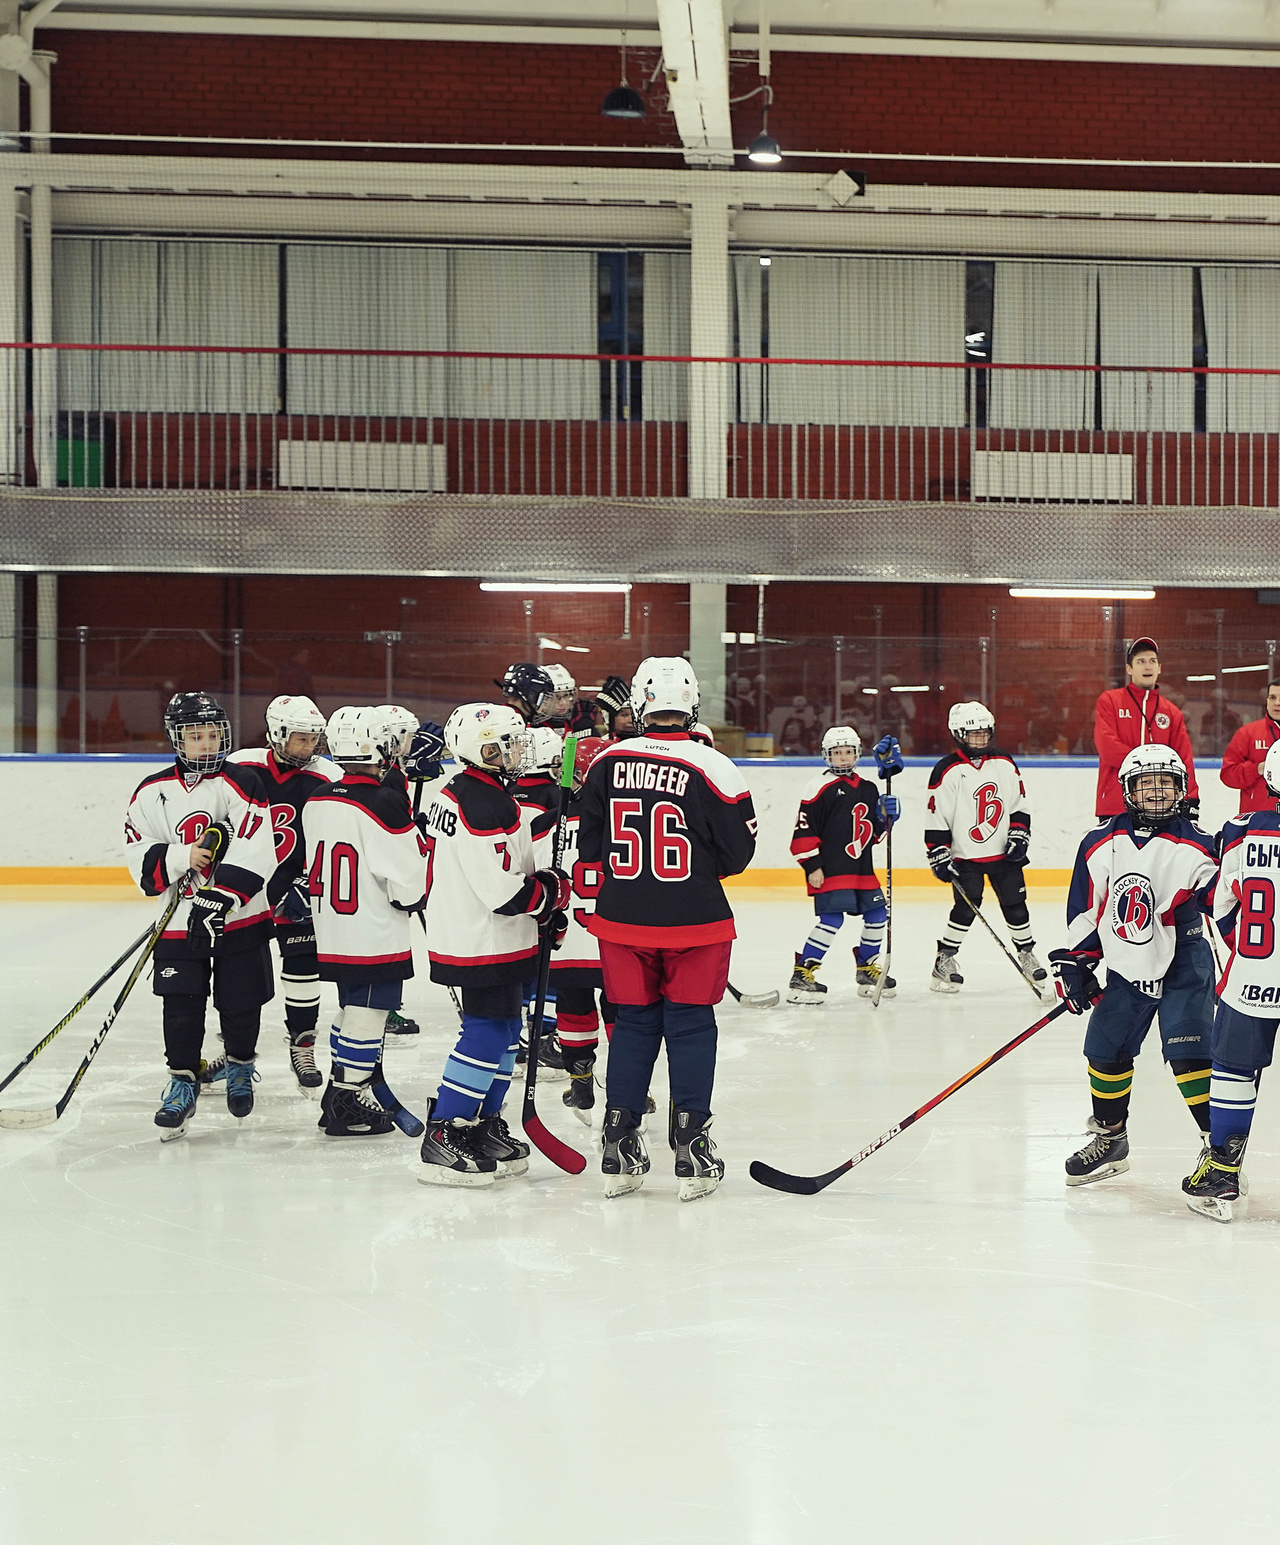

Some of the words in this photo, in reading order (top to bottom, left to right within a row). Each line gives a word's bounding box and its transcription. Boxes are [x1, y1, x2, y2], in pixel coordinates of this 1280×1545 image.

[1118, 709, 1133, 719] D.A.
[645, 744, 670, 752] LUTCH
[613, 761, 690, 797] СКОБЕЕВ
[609, 798, 692, 882] 56
[308, 840, 359, 916] 40
[1114, 877, 1138, 897] HOCKEY
[86, 1005, 117, 1061] CCM
